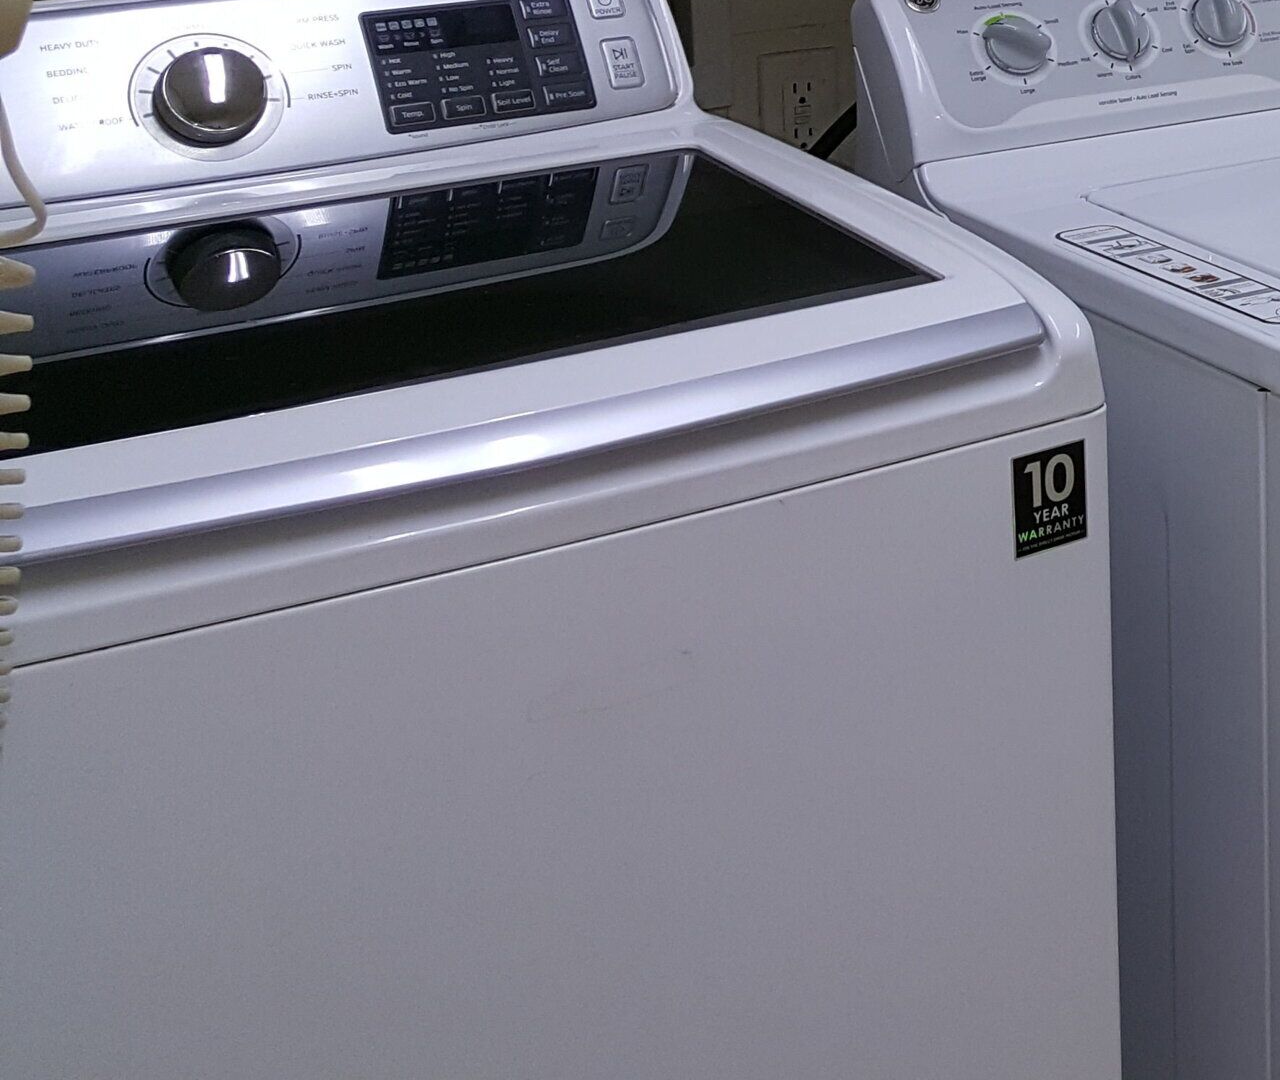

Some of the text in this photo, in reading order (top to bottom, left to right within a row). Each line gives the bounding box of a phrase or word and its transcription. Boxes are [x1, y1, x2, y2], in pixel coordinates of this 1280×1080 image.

[595, 7, 621, 15] POWER
[40, 42, 72, 52] HEAVY
[331, 63, 352, 72] SPIN
[308, 88, 359, 100] RINSE+SPIN
[456, 104, 473, 112] Spin
[1023, 453, 1075, 508] 10
[1033, 503, 1069, 524] YEAR
[1018, 514, 1085, 543] WARRANTY
